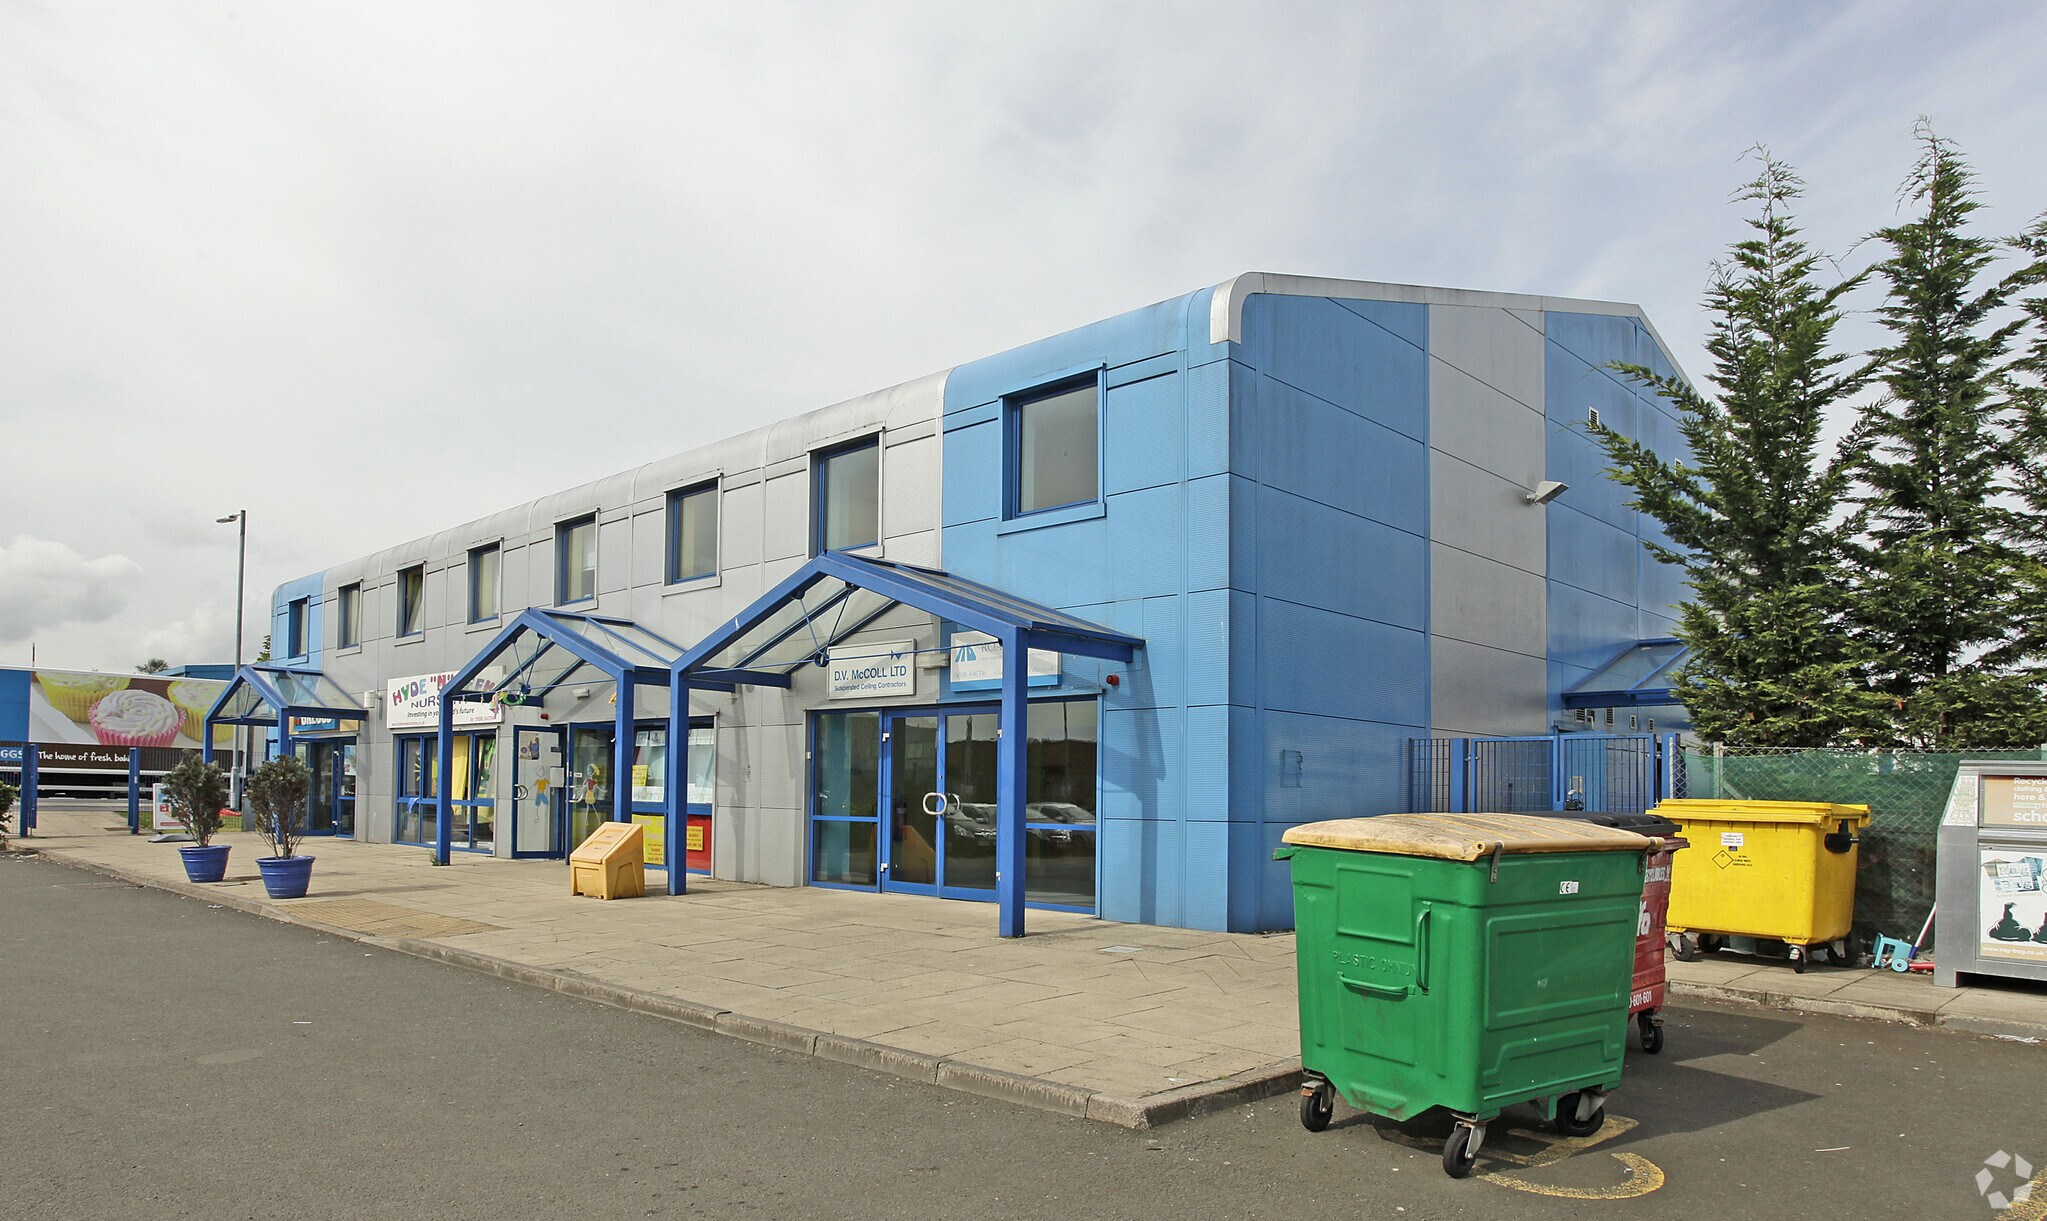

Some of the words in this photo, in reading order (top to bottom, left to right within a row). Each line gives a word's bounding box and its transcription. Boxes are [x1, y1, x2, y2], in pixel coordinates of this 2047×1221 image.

[834, 671, 849, 681] D.V.
[851, 667, 887, 680] McCOLL
[890, 665, 907, 677] LTD
[392, 678, 427, 706] HYDE
[834, 684, 860, 692] Suspended
[861, 682, 877, 691] Ceiling
[877, 681, 906, 689] Contractors
[407, 711, 428, 719] Investing
[38, 751, 53, 760] The
[55, 751, 77, 761] home
[78, 752, 88, 760] of
[90, 752, 112, 762] fresh
[2014, 785, 2043, 794] clothing
[2014, 793, 2036, 801] here
[2012, 802, 2040, 811] money
[1999, 866, 2029, 877] Rag
[1332, 950, 1375, 970] PLASTIC
